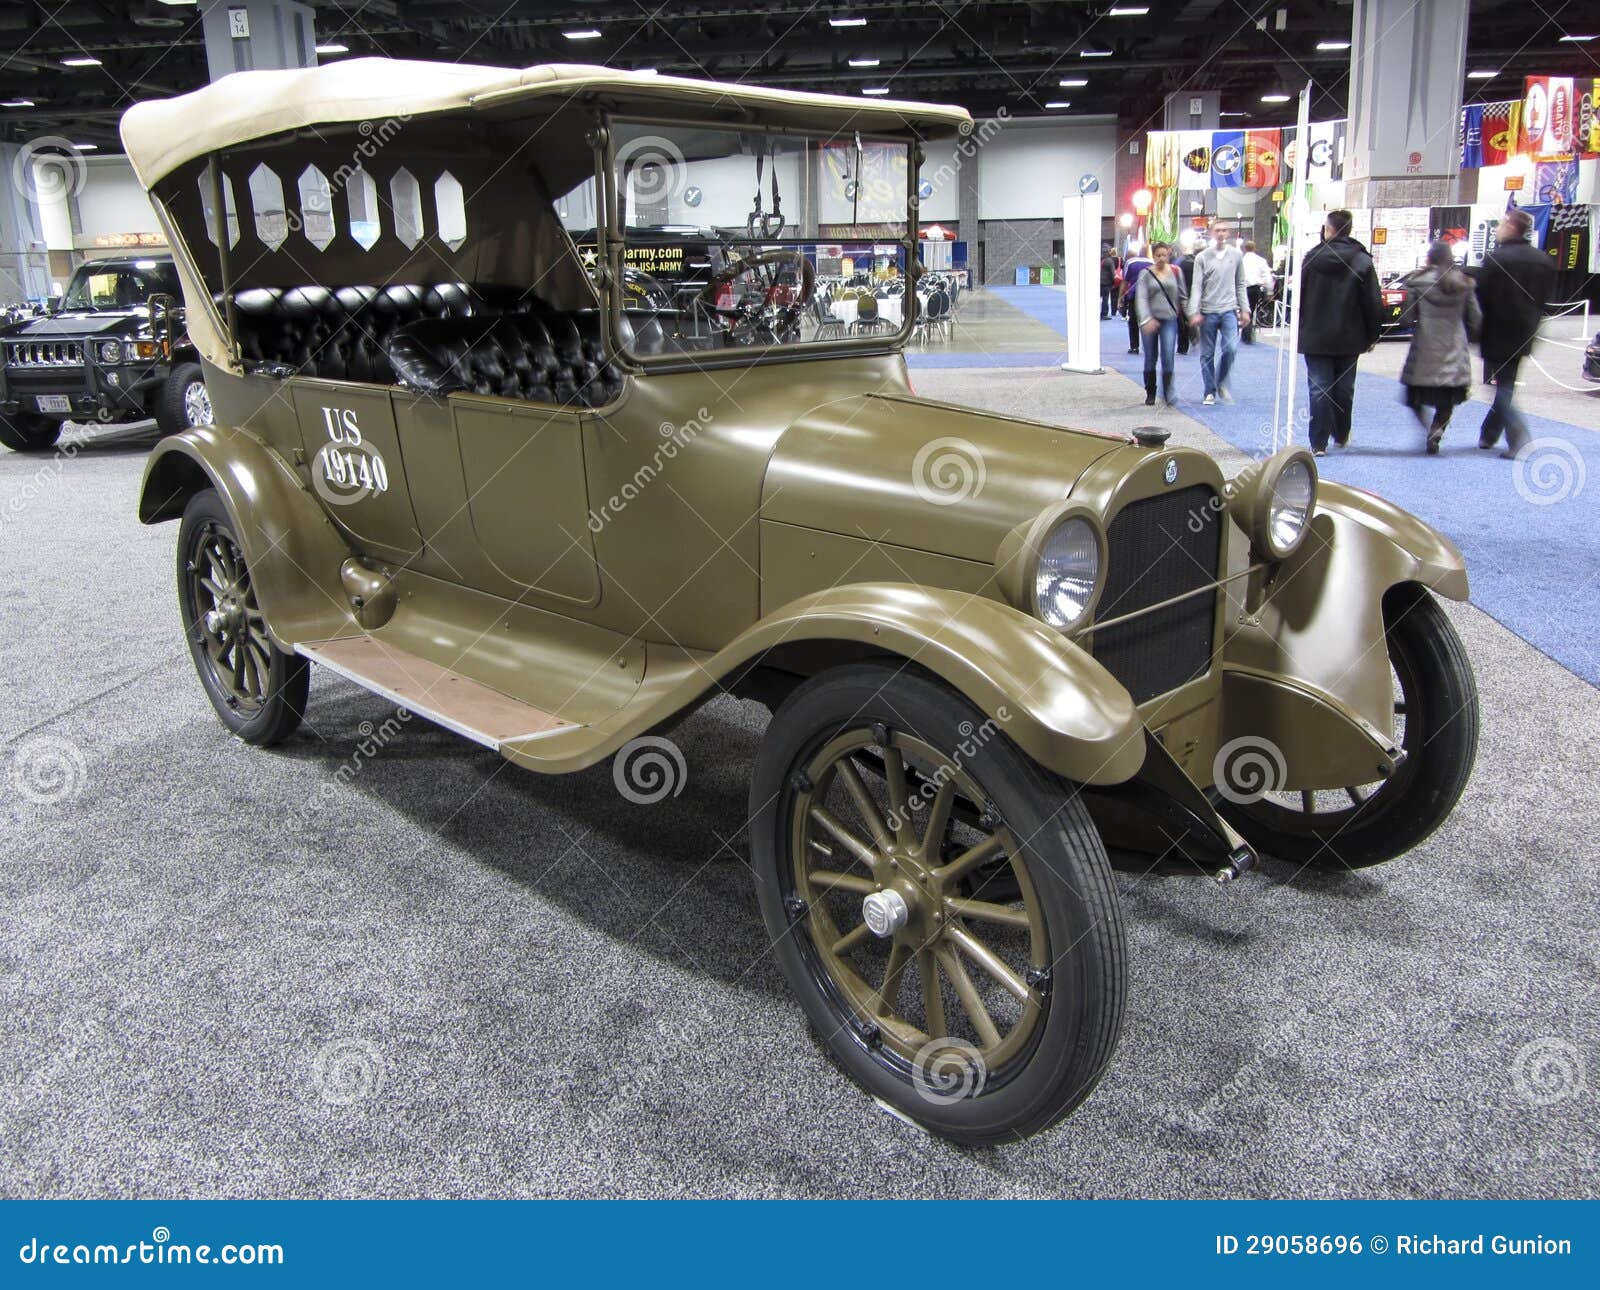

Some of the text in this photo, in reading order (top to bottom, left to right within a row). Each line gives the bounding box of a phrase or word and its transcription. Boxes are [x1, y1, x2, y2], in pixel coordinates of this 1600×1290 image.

[235, 24, 245, 34] 14
[1554, 91, 1565, 137] BUGATTI
[1568, 234, 1579, 269] Ferrari
[322, 407, 362, 446] US
[321, 447, 389, 491] 19140
